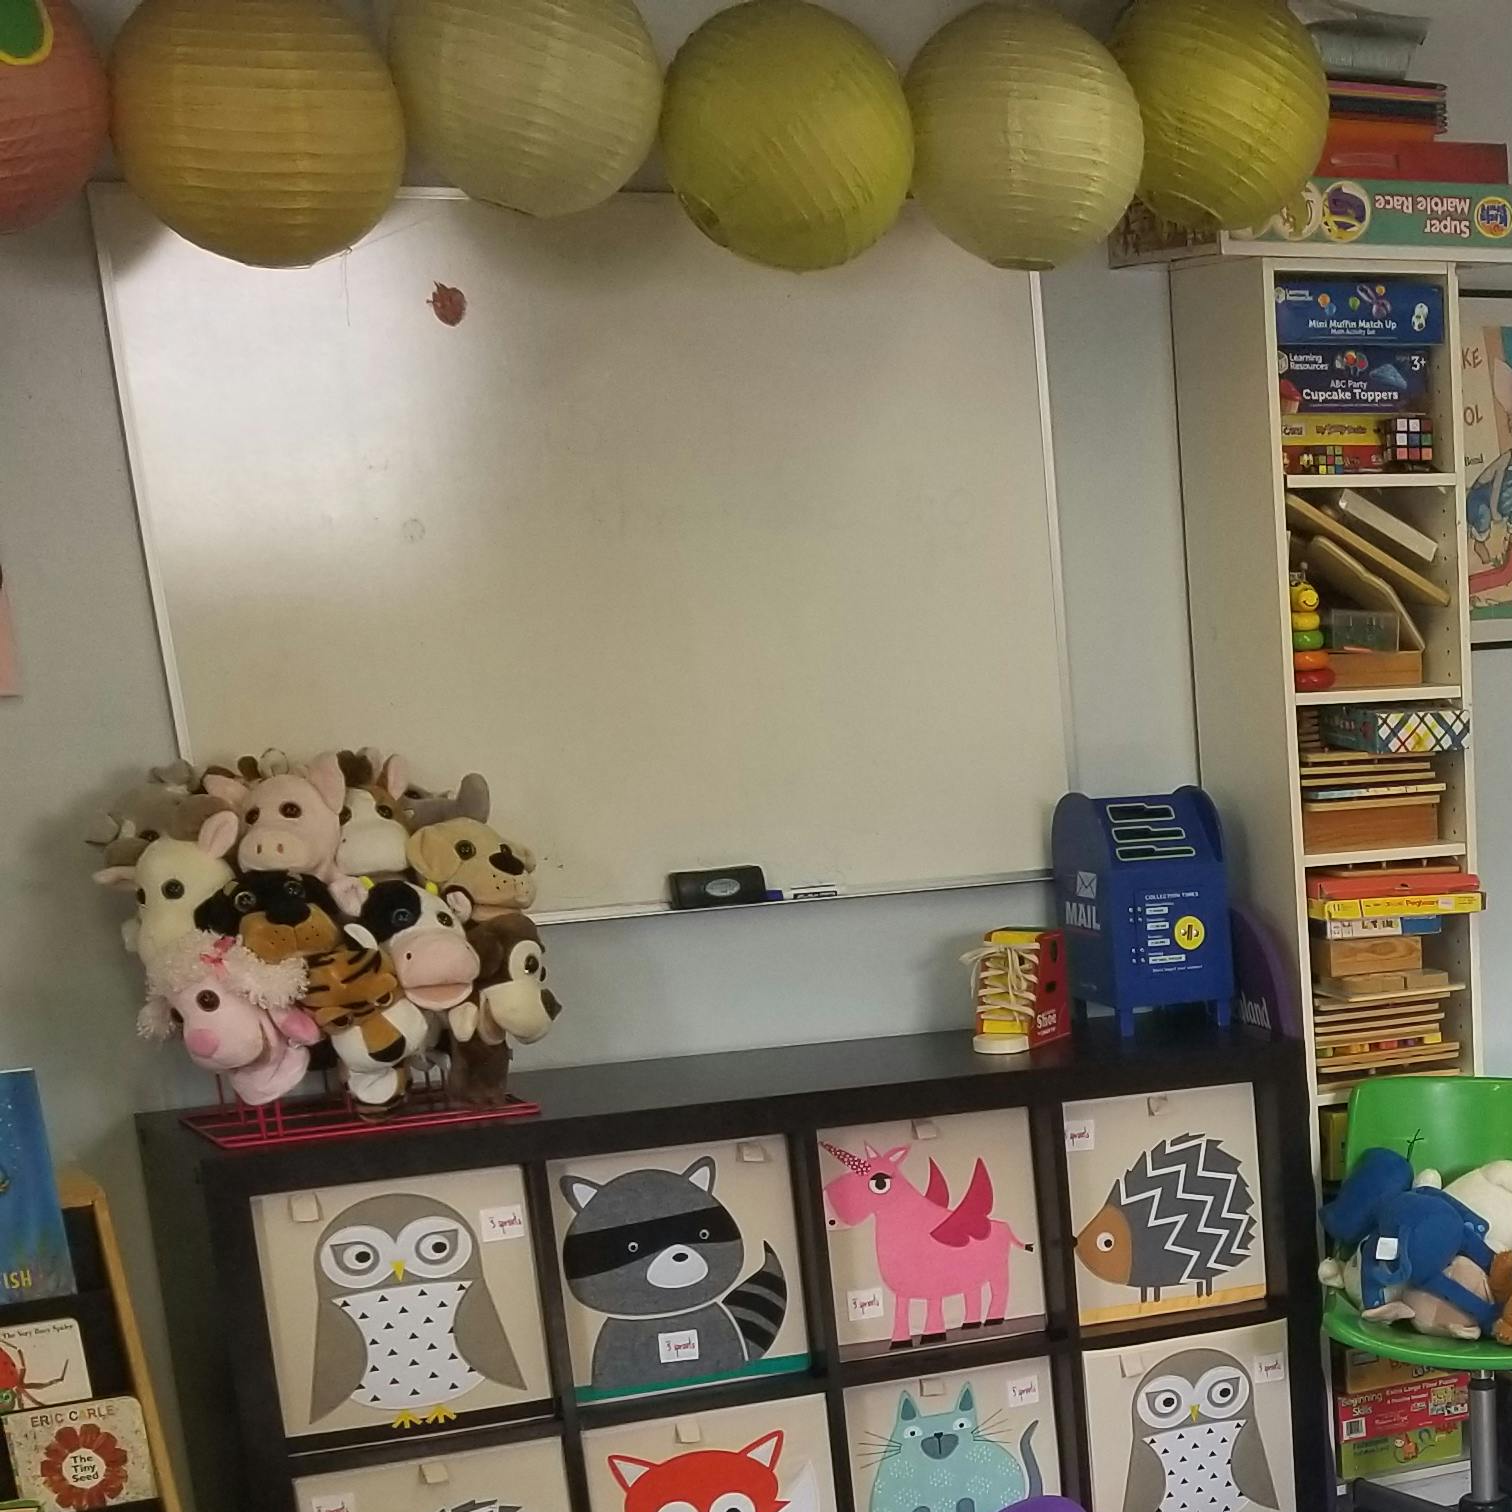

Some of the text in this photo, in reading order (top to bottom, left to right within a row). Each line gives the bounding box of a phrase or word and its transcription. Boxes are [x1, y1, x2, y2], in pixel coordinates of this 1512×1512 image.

[1375, 194, 1414, 214] Race
[1417, 197, 1471, 216] Marble
[1424, 217, 1470, 238] Super
[1358, 319, 1383, 329] Match
[1384, 320, 1397, 331] Up
[1289, 353, 1322, 364] Learning
[1410, 355, 1426, 371] 3+
[1289, 362, 1329, 371] Resources
[1329, 380, 1368, 390] ABC Party
[1302, 389, 1399, 402] Cupcake Toppers
[1065, 901, 1101, 931] MAIL
[30, 1413, 64, 1428] ERIC
[71, 1455, 93, 1464] The
[72, 1463, 96, 1474] Tiny
[71, 1472, 99, 1483] Seed
